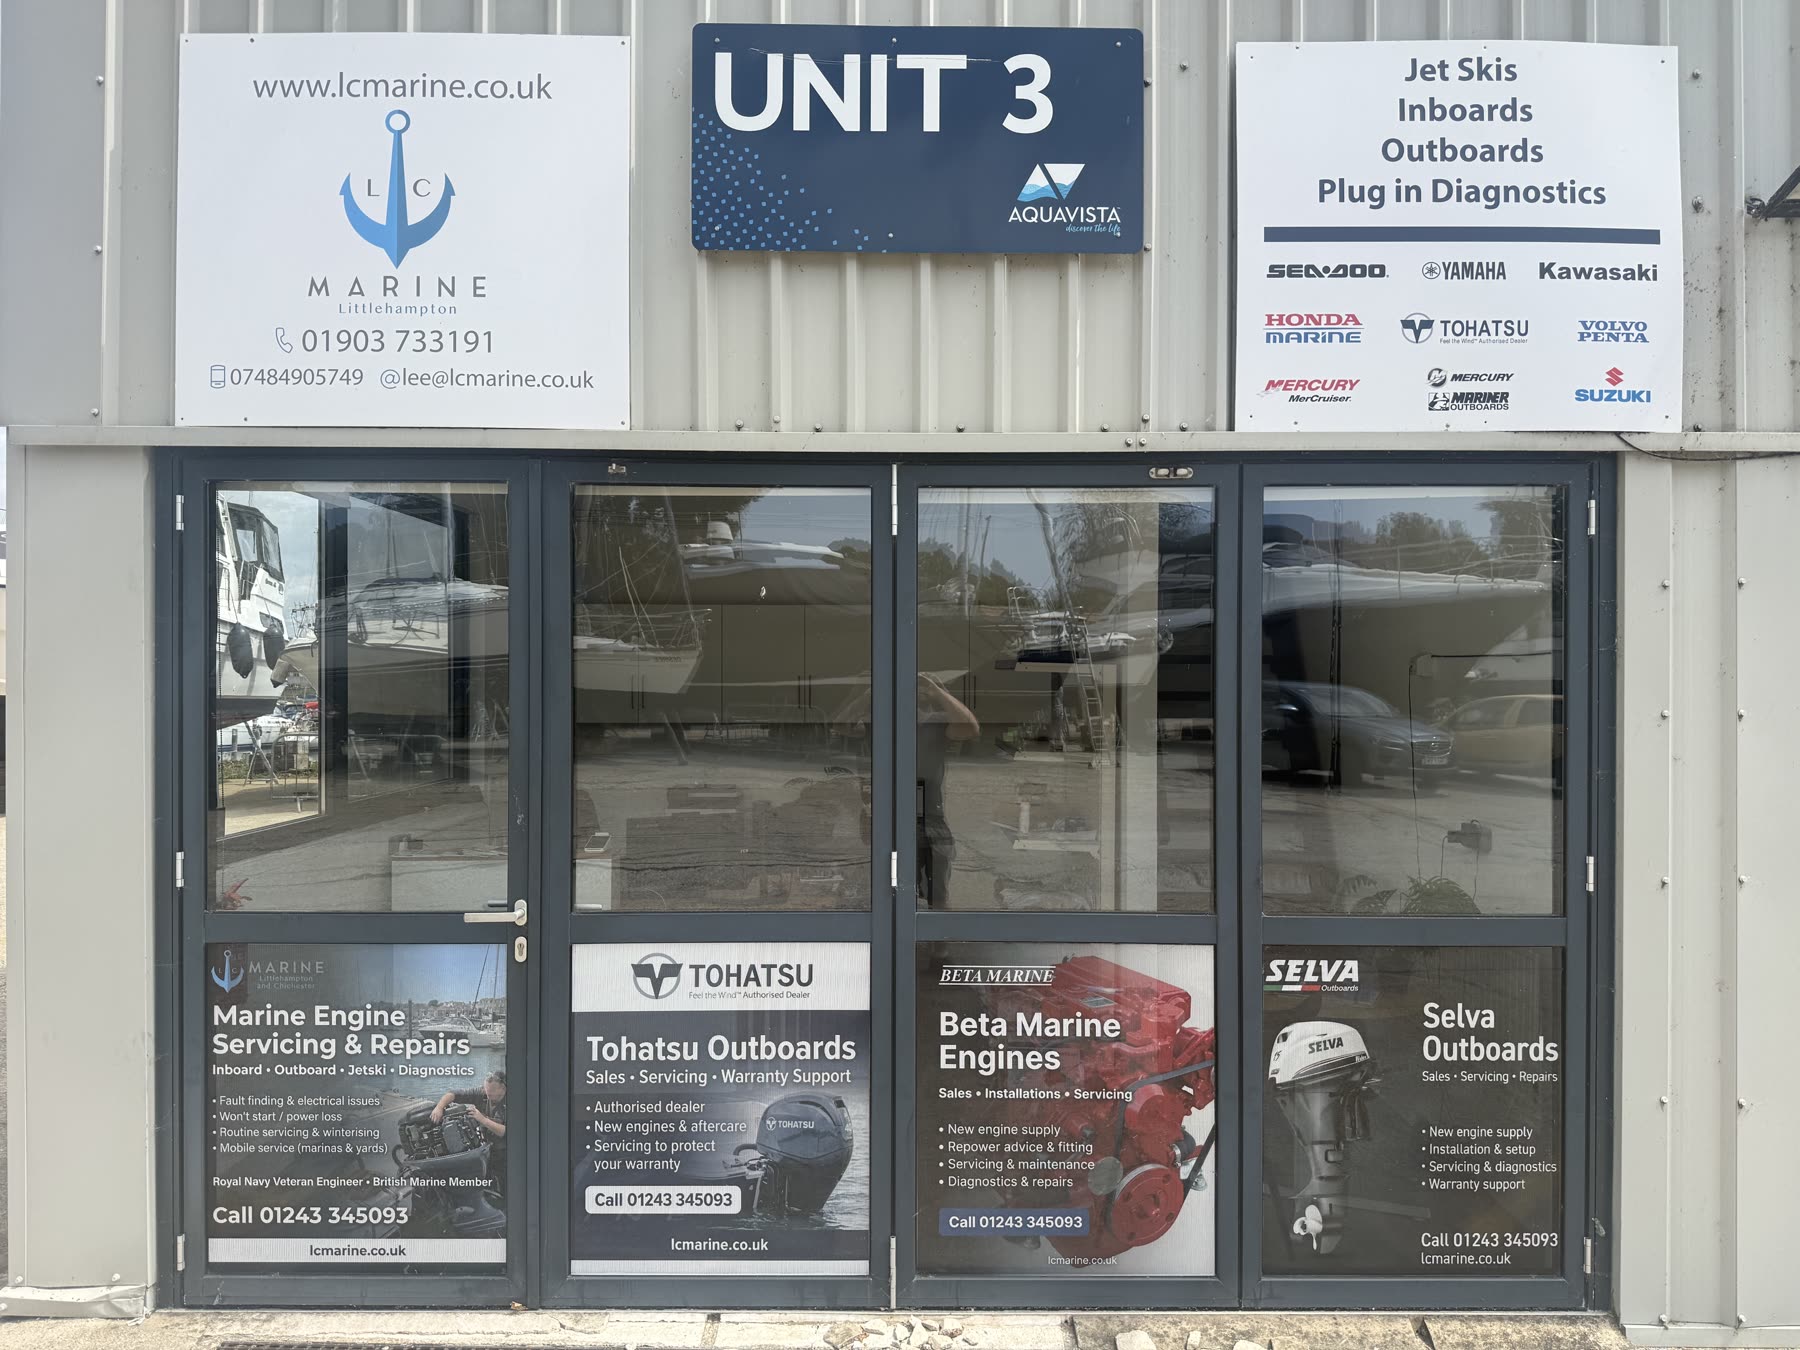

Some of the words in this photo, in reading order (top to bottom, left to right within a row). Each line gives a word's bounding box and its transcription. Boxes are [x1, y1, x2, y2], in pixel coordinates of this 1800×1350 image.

[1404, 57, 1449, 82] Jet
[1458, 57, 1518, 82] Skis
[253, 72, 552, 100] www.lcmarine.co.uk
[714, 52, 967, 132] UNIT
[1002, 53, 1053, 134] 3
[1399, 97, 1533, 122] Inboards
[1381, 138, 1544, 163] Outboards
[367, 179, 380, 197] L
[413, 178, 431, 197] C
[1318, 178, 1386, 209] Plug
[1395, 179, 1422, 202] in
[1432, 178, 1607, 210] Diagnostics
[1065, 223, 1093, 233] discover
[1094, 223, 1107, 232] the
[1108, 224, 1121, 236] life
[1442, 261, 1506, 280] YAMAHA
[1539, 262, 1658, 281] Kawasaki
[308, 276, 487, 298] MARINE
[339, 303, 458, 316] Littlehampton
[1265, 313, 1363, 326] HONDA
[1578, 320, 1648, 331] VOLVO
[1440, 320, 1529, 337] TOHATSU
[301, 330, 385, 352] 01903
[395, 330, 494, 353] 733191
[1577, 331, 1649, 343] PENTA
[230, 368, 364, 386] 07484905749
[1450, 373, 1514, 382] MERCURY
[1265, 379, 1361, 391] MERCURY
[1451, 392, 1510, 404] MARINER
[1575, 389, 1651, 403] SUZUKI
[1450, 403, 1509, 411] OUTBOARDS
[249, 961, 324, 974] MARINE
[1265, 960, 1359, 982] SELVA
[689, 963, 813, 987] TOHATSU
[940, 969, 982, 982] BETA
[986, 969, 1054, 983] MARINE
[742, 990, 784, 999] Authorised
[786, 990, 810, 999] Dealer
[213, 1004, 305, 1026] Marine
[314, 1003, 406, 1031] Engine
[1423, 1002, 1495, 1029] Selva
[940, 1011, 1007, 1037] Beta
[1016, 1012, 1121, 1037] Marine
[212, 1033, 336, 1060] Servicing
[344, 1035, 362, 1054] &
[371, 1033, 470, 1059] Repairs
[587, 1036, 698, 1061] Tohatsu
[708, 1035, 856, 1061] Outboards
[1308, 1037, 1344, 1054] SELVA
[1423, 1035, 1559, 1062] Outboards
[940, 1044, 1061, 1075] Engines
[212, 1065, 262, 1075] Inboard
[274, 1065, 336, 1076] Outboard
[348, 1065, 386, 1075] Jetski
[399, 1065, 474, 1078] Diagnostics
[586, 1069, 625, 1084] Sales
[639, 1069, 708, 1086] Servicing
[721, 1069, 788, 1086] Warranty
[793, 1069, 851, 1086] Support
[1422, 1071, 1451, 1082] Sales
[1460, 1071, 1509, 1084] Servicing
[1519, 1071, 1558, 1084] Repairs
[939, 1088, 972, 1099] Sales
[985, 1088, 1061, 1099] Installations
[1074, 1089, 1132, 1102] Servicing
[219, 1096, 244, 1106] Fault
[247, 1096, 284, 1108] finding
[287, 1096, 294, 1106] &
[297, 1096, 345, 1106] electrical
[348, 1097, 380, 1106] issues
[594, 1101, 662, 1113] Authorised
[666, 1101, 705, 1113] dealer
[219, 1112, 250, 1121] Won't
[252, 1112, 276, 1121] start
[286, 1113, 319, 1124] power
[322, 1112, 342, 1121] loss
[595, 1121, 623, 1132] New
[626, 1121, 675, 1135] engines
[679, 1121, 687, 1132] &
[691, 1120, 747, 1132] aftercare
[778, 1121, 815, 1129] TOHATSU
[948, 1124, 974, 1134] New
[978, 1125, 1018, 1137] engine
[1021, 1124, 1061, 1137] supply
[219, 1128, 260, 1137] Routine
[262, 1128, 309, 1140] servicing
[312, 1128, 320, 1137] &
[323, 1128, 380, 1140] winterising
[1429, 1126, 1453, 1137] New
[1457, 1127, 1493, 1140] engine
[1496, 1127, 1533, 1140] supply
[220, 1143, 255, 1153] Mobile
[258, 1144, 295, 1153] service
[297, 1143, 343, 1155] (marinas
[346, 1144, 353, 1153] &
[356, 1143, 388, 1155] yards)
[594, 1140, 652, 1154] Servicing
[655, 1141, 668, 1151] to
[671, 1140, 715, 1154] protect
[948, 1142, 1000, 1154] Repower
[1004, 1142, 1044, 1152] advice
[1047, 1142, 1055, 1152] &
[1058, 1142, 1093, 1155] fitting
[1429, 1144, 1490, 1155] Installation
[1494, 1145, 1502, 1154] &
[1506, 1145, 1536, 1157] setup
[594, 1159, 622, 1172] your
[625, 1159, 680, 1172] warranty
[948, 1159, 1003, 1172] Servicing
[1007, 1160, 1015, 1170] &
[1018, 1160, 1095, 1170] maintenance
[1429, 1161, 1480, 1174] Servicing
[1483, 1162, 1492, 1172] &
[1495, 1161, 1557, 1174] diagnostics
[213, 1176, 242, 1188] Royal
[244, 1177, 271, 1188] Navy
[273, 1177, 314, 1187] Veteran
[316, 1177, 363, 1188] Engineer
[373, 1177, 407, 1187] British
[410, 1177, 446, 1187] Marine
[449, 1177, 492, 1187] Member
[948, 1177, 1017, 1189] Diagnostics
[1021, 1177, 1029, 1187] &
[1032, 1177, 1073, 1189] repairs
[1429, 1179, 1480, 1192] Warranty
[1483, 1179, 1525, 1192] support
[595, 1193, 623, 1206] Call
[627, 1193, 672, 1206] 01243
[676, 1193, 732, 1206] 345093
[212, 1206, 253, 1224] Call
[260, 1206, 322, 1224] 01243
[328, 1207, 409, 1224] 345093
[949, 1216, 976, 1228] Call
[979, 1216, 1023, 1228] 01243
[1026, 1216, 1083, 1228] 345093
[671, 1238, 768, 1251] lcmarine.co.uk
[1421, 1233, 1449, 1247] Call
[1453, 1233, 1498, 1247] 01243
[1503, 1233, 1558, 1247] 345093
[309, 1245, 406, 1257] lcmarine.co.uk
[1048, 1255, 1117, 1265] lcmarine.co.uk
[1421, 1252, 1511, 1265] lcmarine.co.uk
